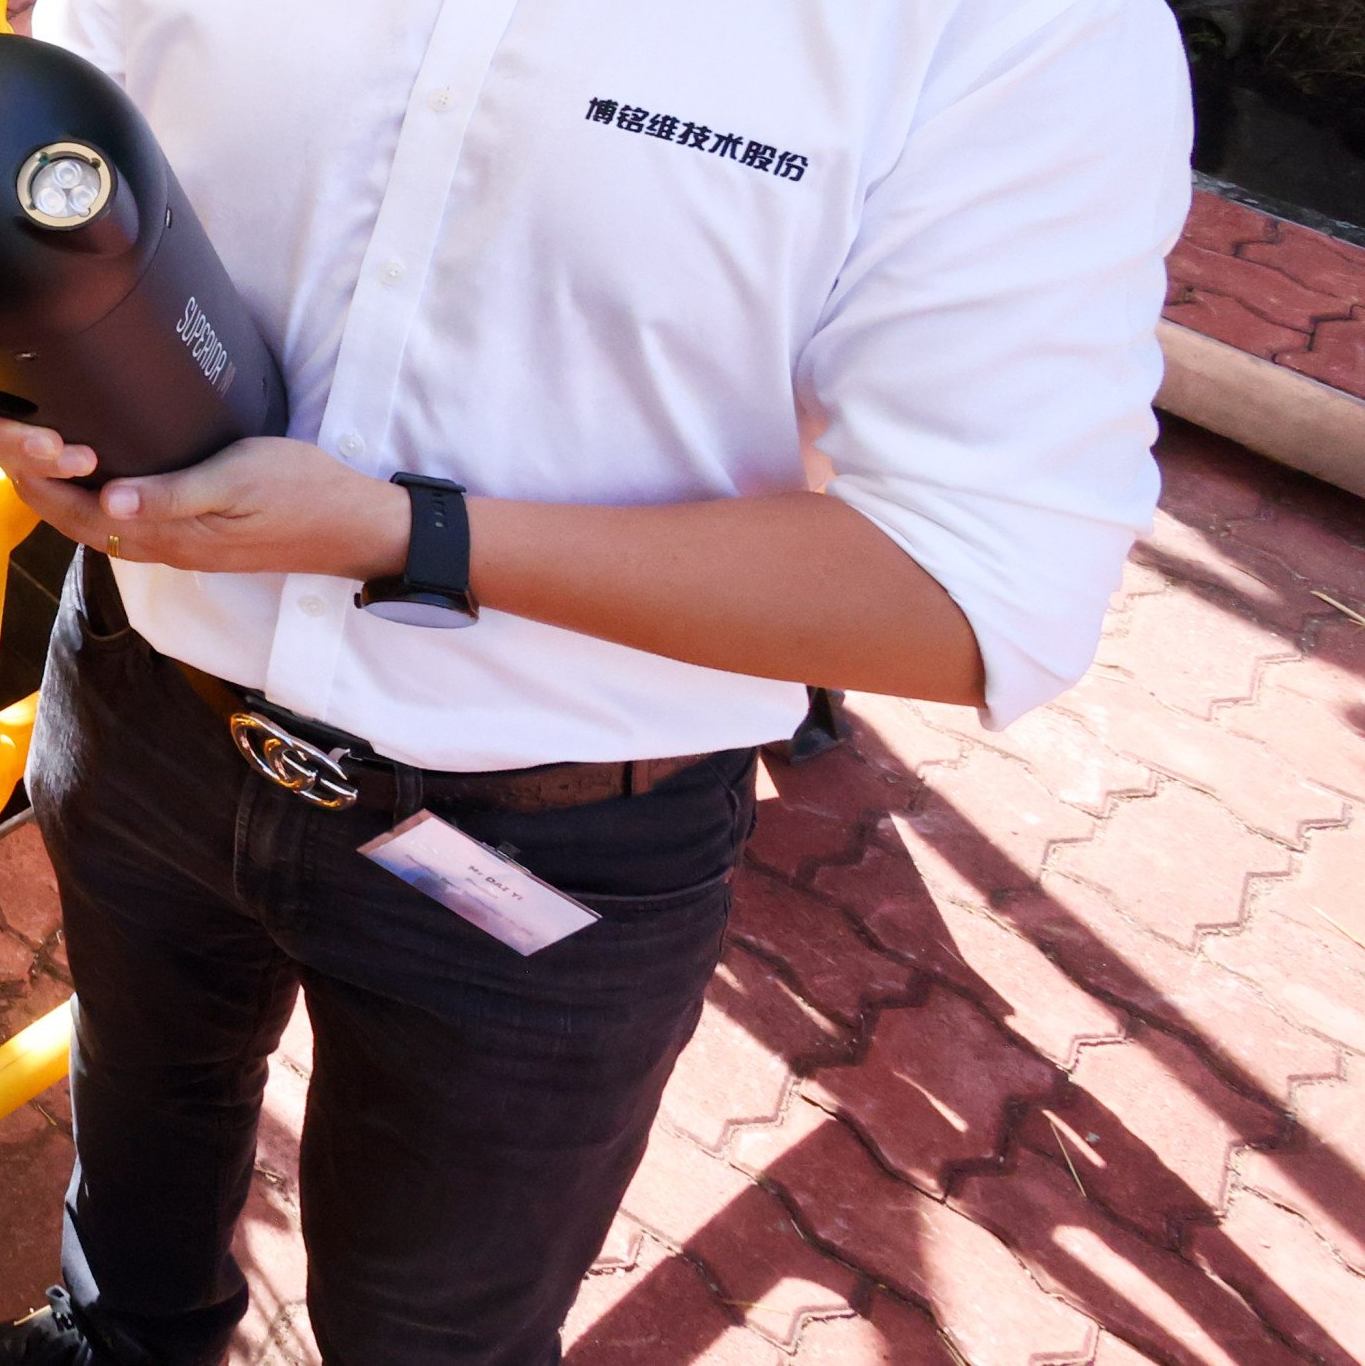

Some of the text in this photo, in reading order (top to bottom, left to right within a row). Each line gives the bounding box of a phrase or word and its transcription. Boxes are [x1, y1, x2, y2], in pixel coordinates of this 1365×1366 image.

[584, 96, 809, 182] 博铭维技术股份
[176, 296, 228, 385] SUPERIOR
